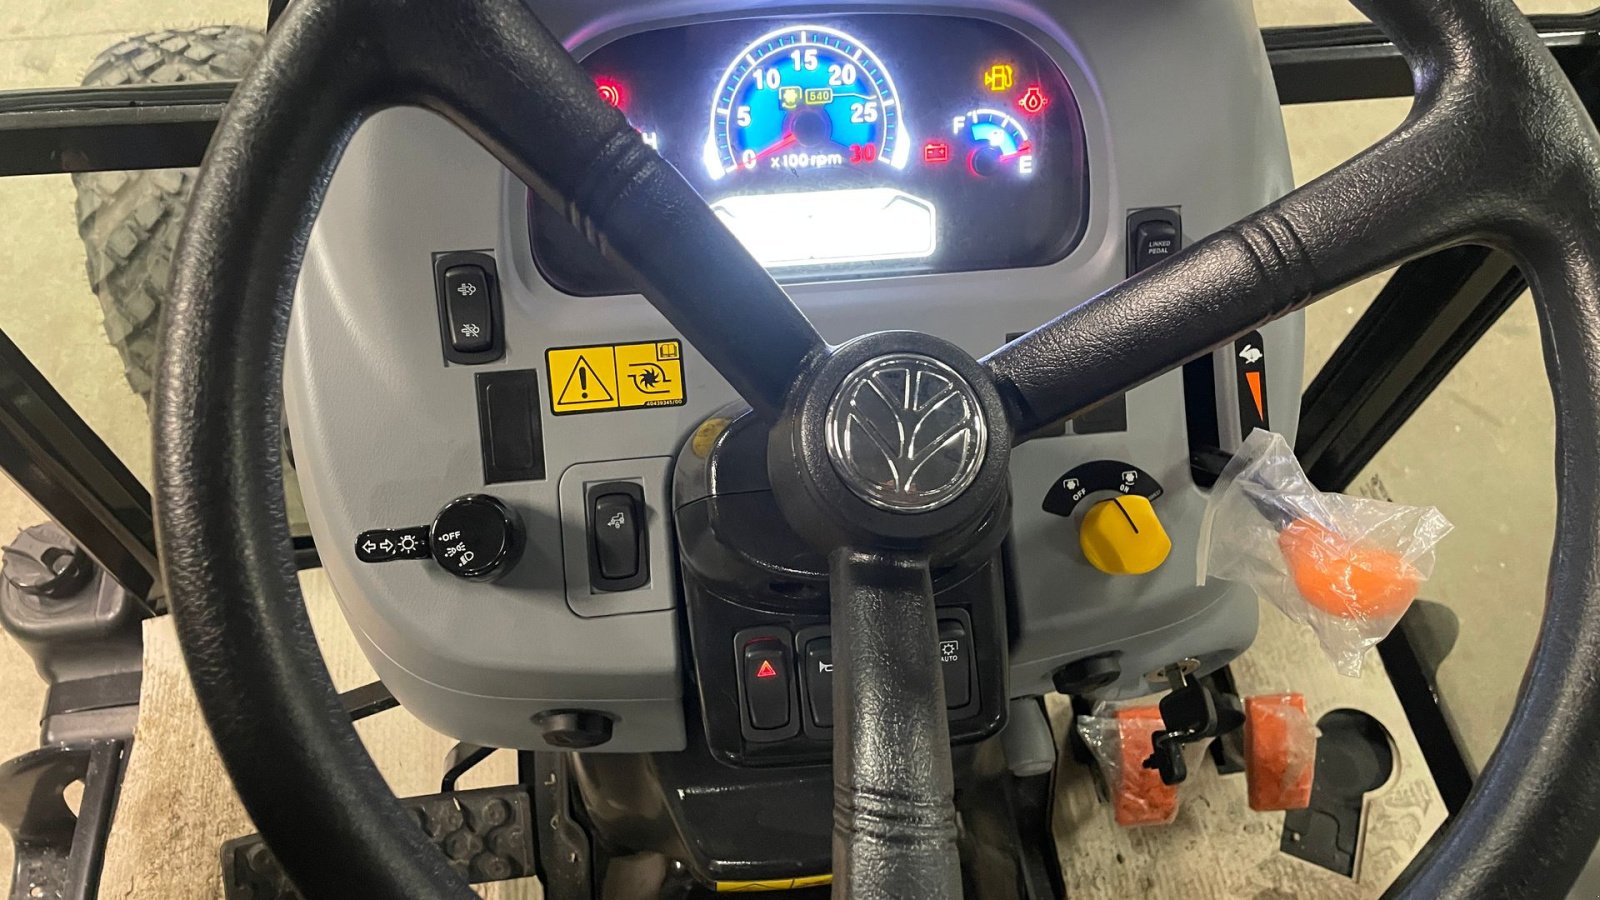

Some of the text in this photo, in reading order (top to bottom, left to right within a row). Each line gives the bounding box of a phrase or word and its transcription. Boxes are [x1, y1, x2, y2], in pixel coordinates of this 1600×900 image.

[791, 49, 818, 71] 15
[753, 68, 781, 90] 10
[828, 64, 857, 86] 20
[809, 91, 830, 102] 540
[737, 106, 751, 127] 5
[850, 102, 878, 123] 25
[953, 116, 966, 135] F
[742, 149, 757, 169] 0
[810, 152, 842, 169] rpm
[849, 144, 877, 165] 30
[1019, 155, 1033, 174] E
[1148, 240, 1171, 248] LINKED
[1148, 247, 1168, 255] PEDAL
[1072, 488, 1086, 501] OFF
[1119, 484, 1130, 493] ON
[442, 531, 461, 542] OFF
